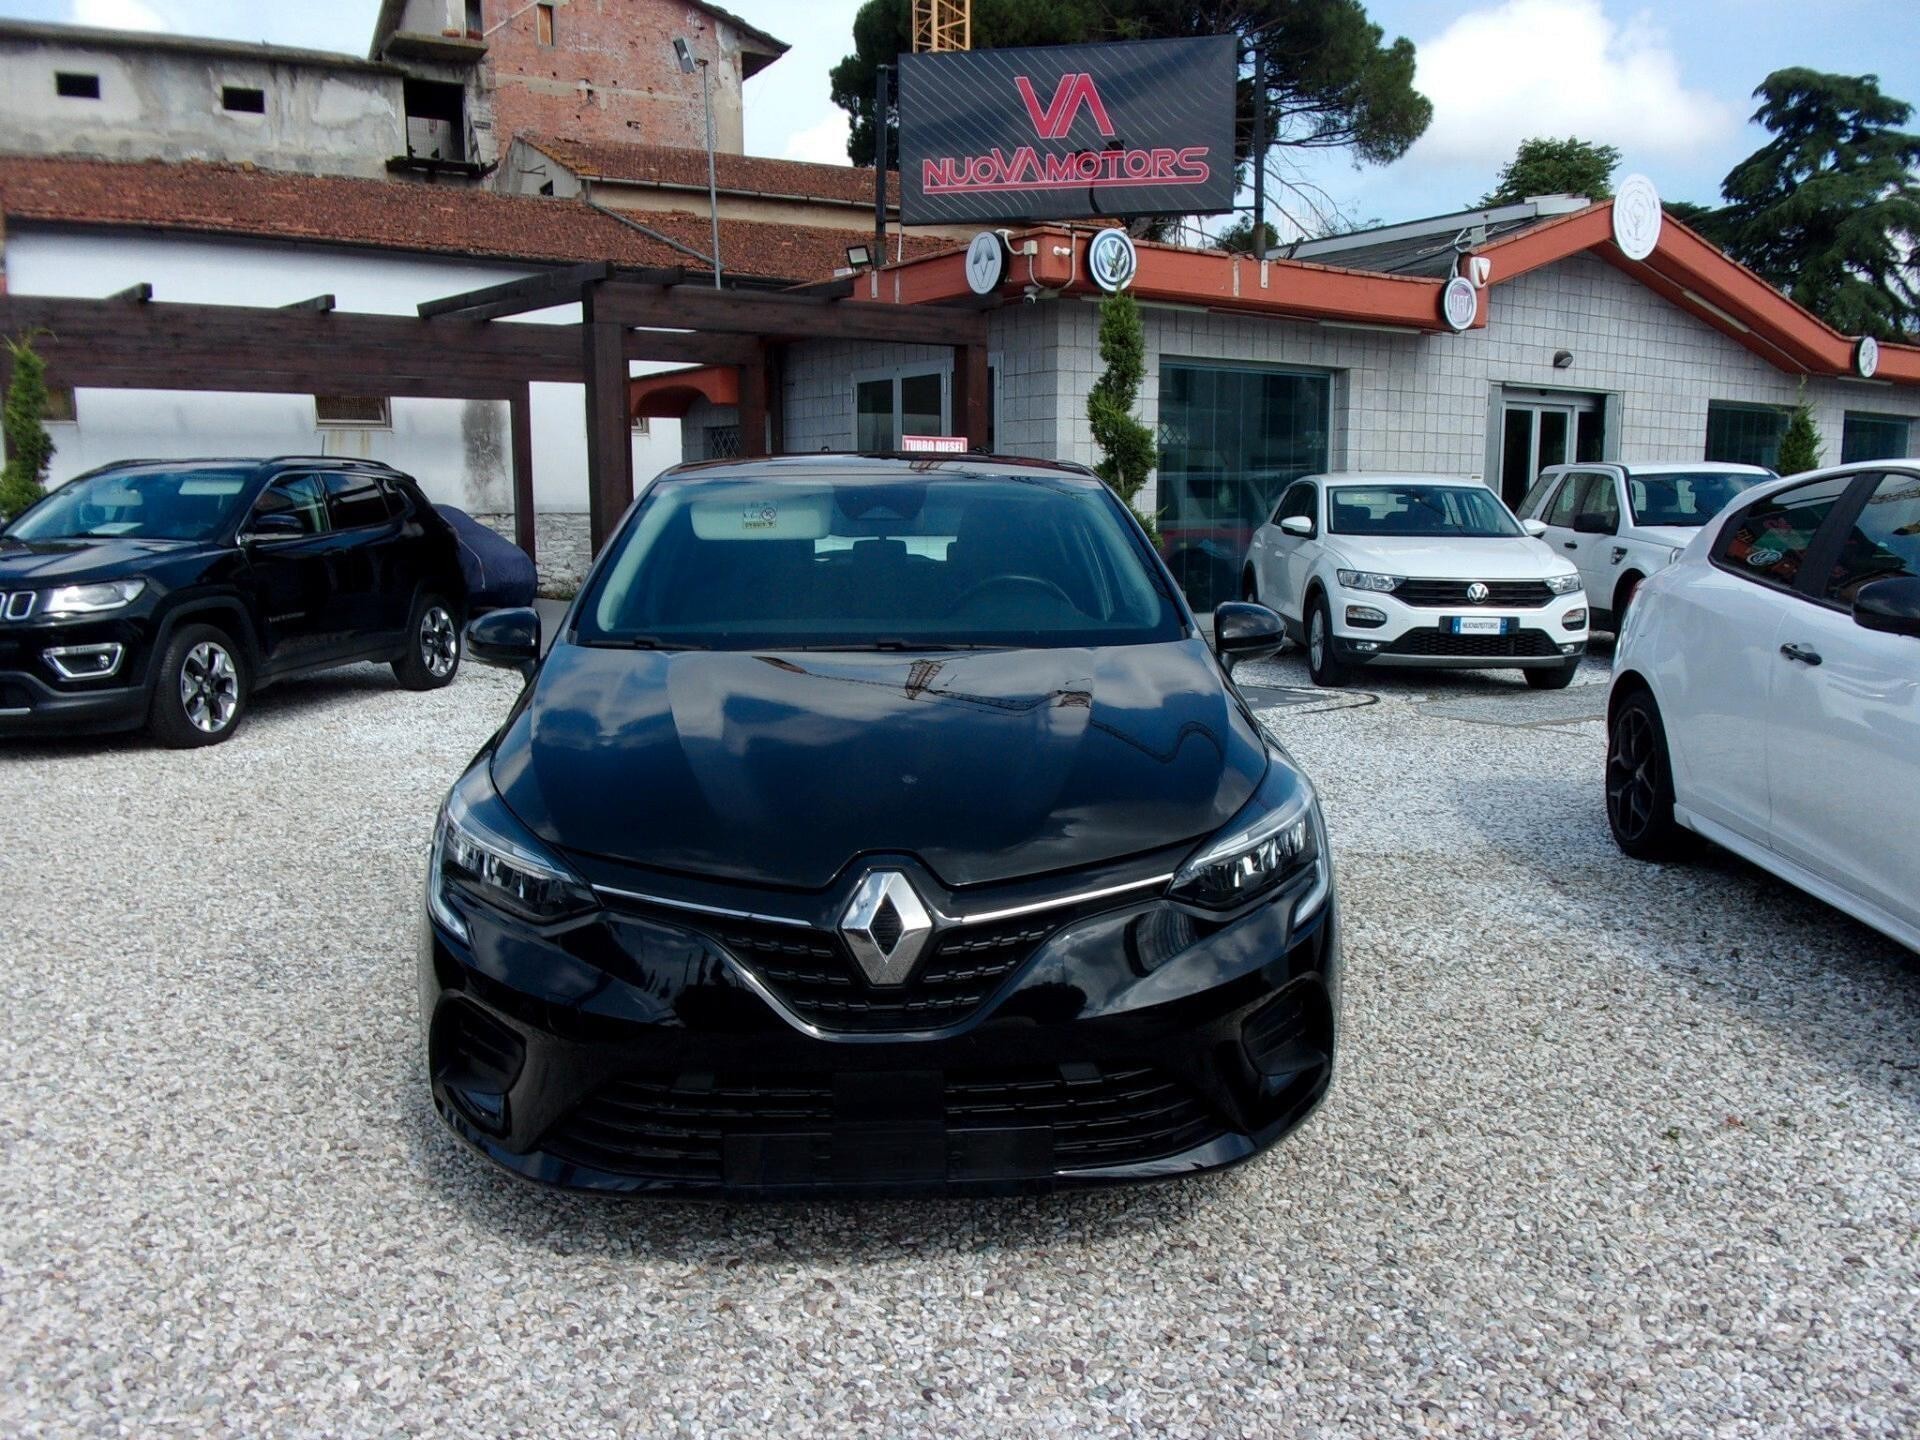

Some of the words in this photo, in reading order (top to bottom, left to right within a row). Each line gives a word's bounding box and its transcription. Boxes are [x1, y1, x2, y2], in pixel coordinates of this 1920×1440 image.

[1014, 73, 1115, 139] VA
[905, 440, 934, 451] TURBO
[936, 440, 963, 452] DIESEL
